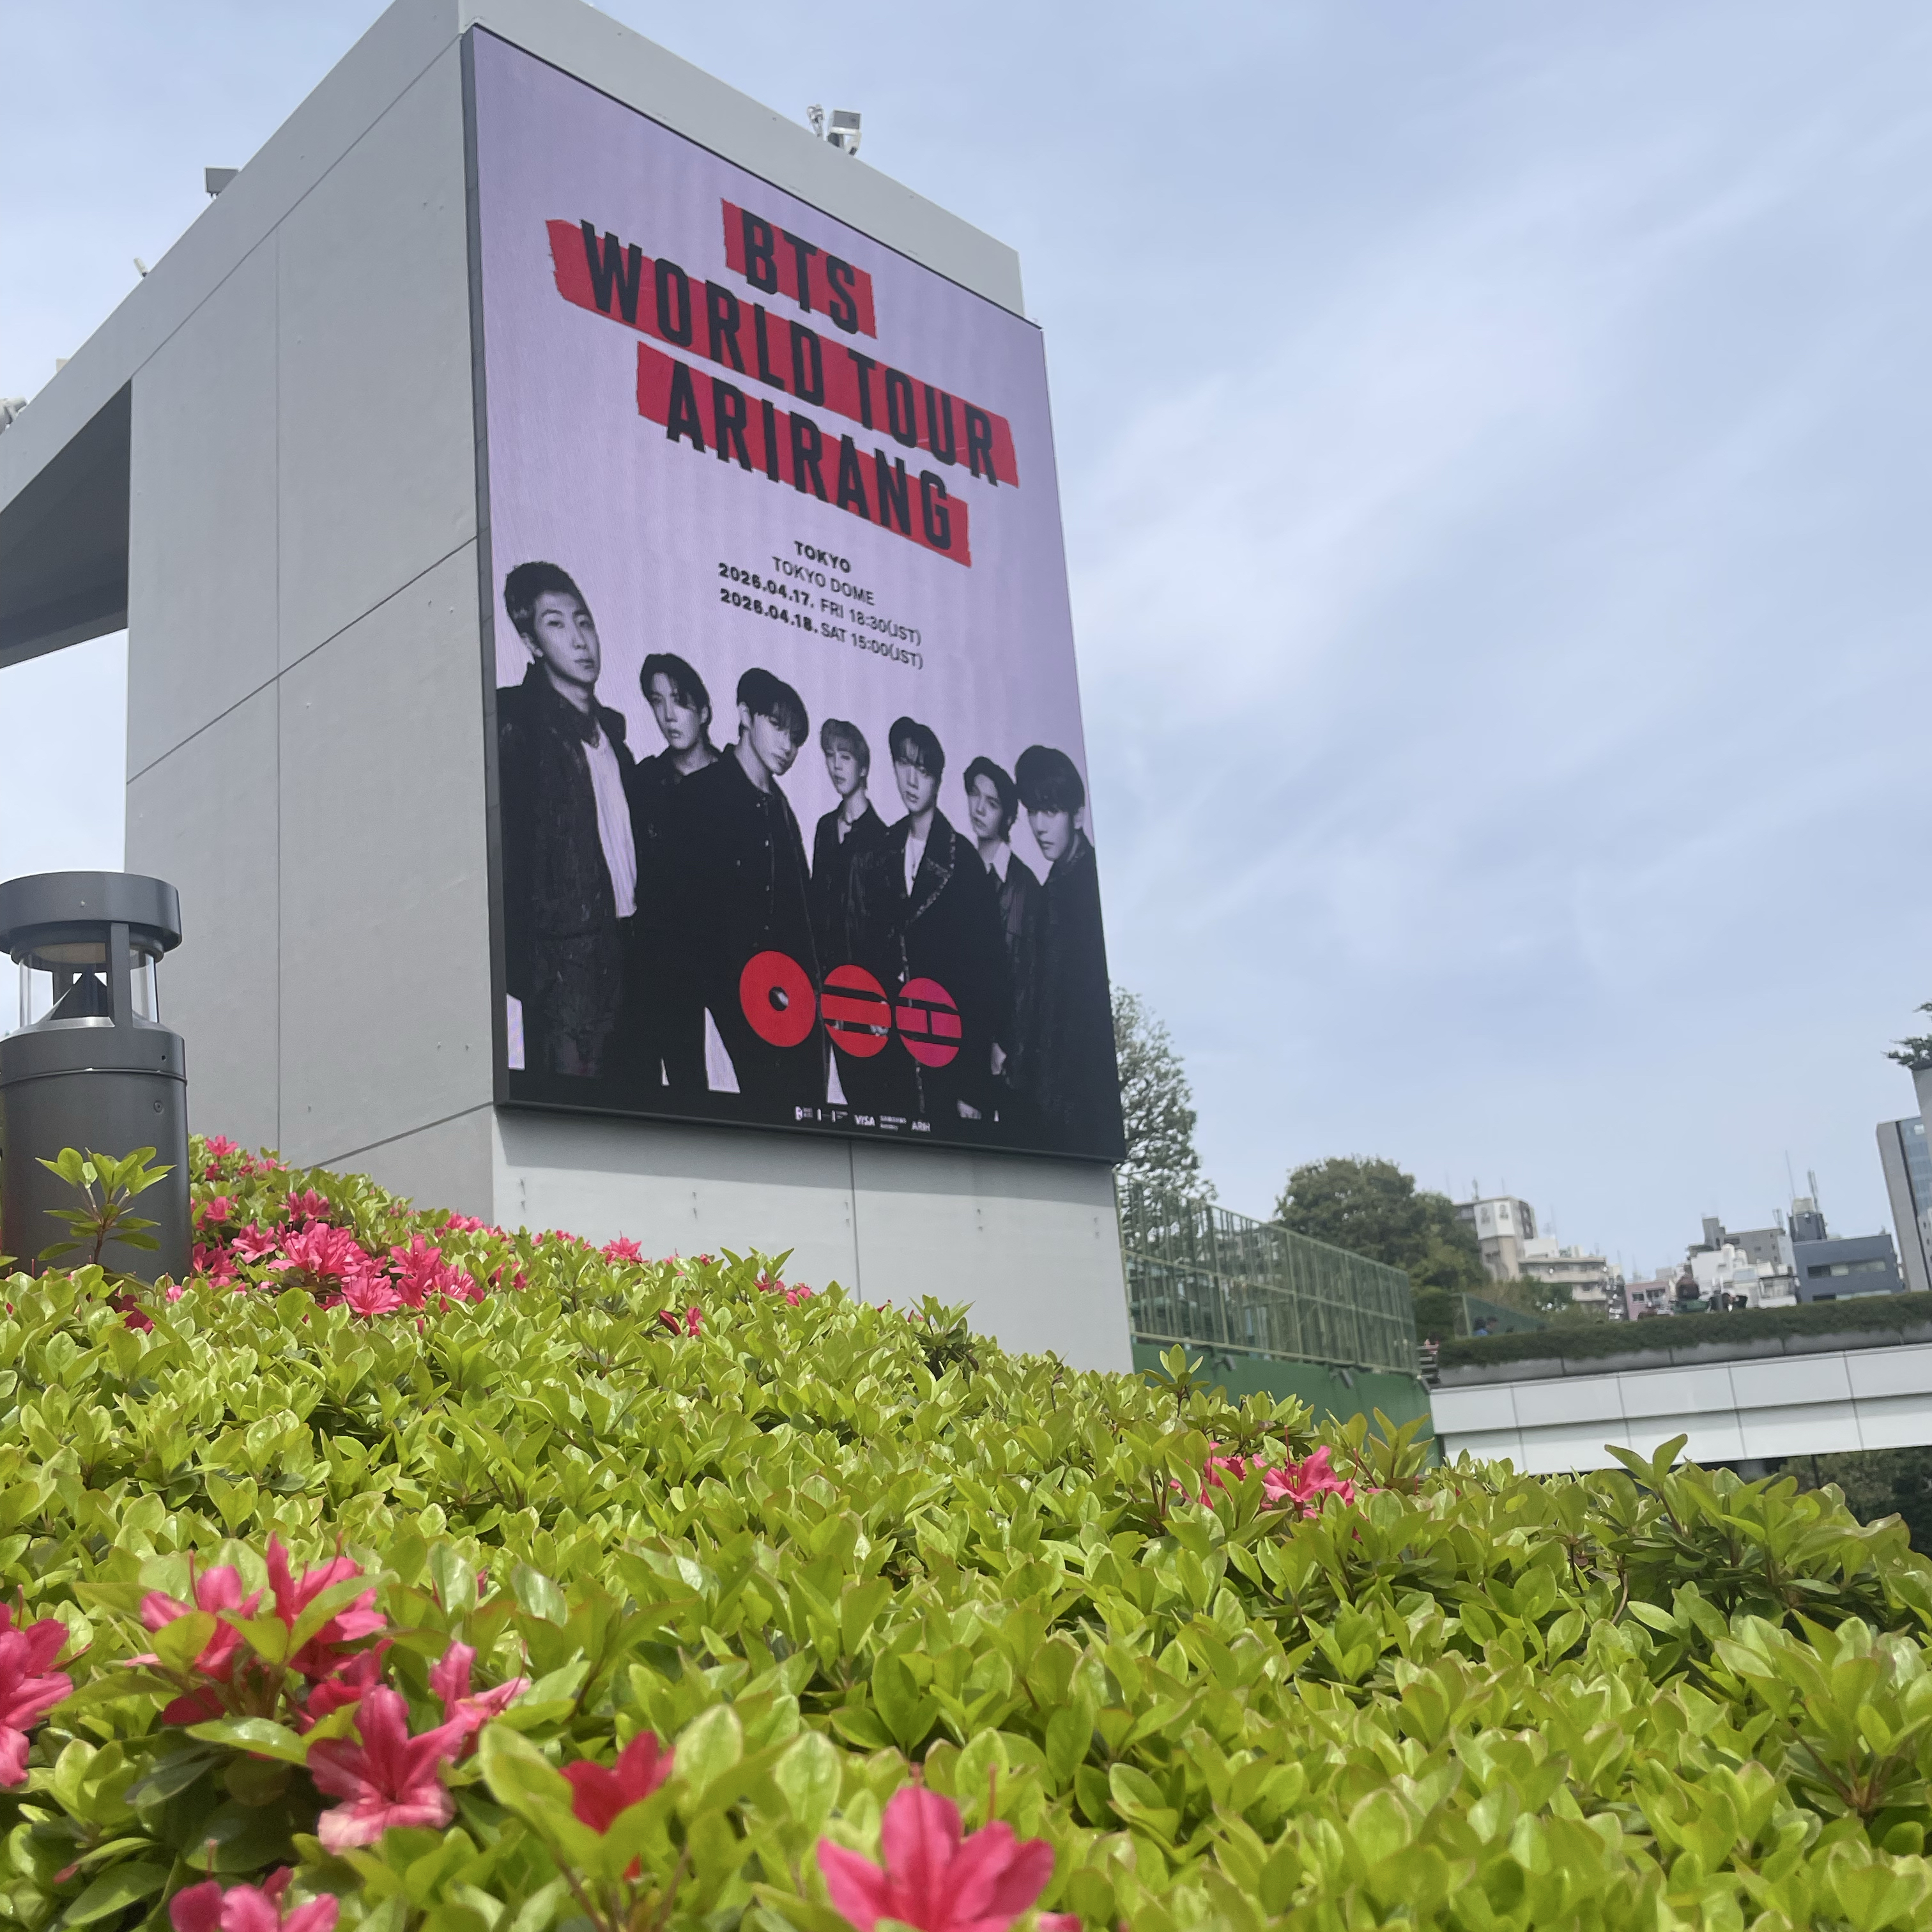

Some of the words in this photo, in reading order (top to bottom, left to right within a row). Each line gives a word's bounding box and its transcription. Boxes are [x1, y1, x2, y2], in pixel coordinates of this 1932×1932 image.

[741, 208, 860, 334] BTS
[580, 219, 824, 406] WORLD
[848, 347, 999, 486] TOUR
[666, 360, 951, 551] ARIRANG
[772, 556, 826, 588] TOKYO
[831, 578, 875, 606] DOME
[794, 540, 851, 573] TOKYO
[820, 598, 844, 618] FRI
[850, 608, 922, 647] 18:30(JST)
[820, 622, 847, 643] SAT
[851, 632, 924, 670] 15:00(JST)
